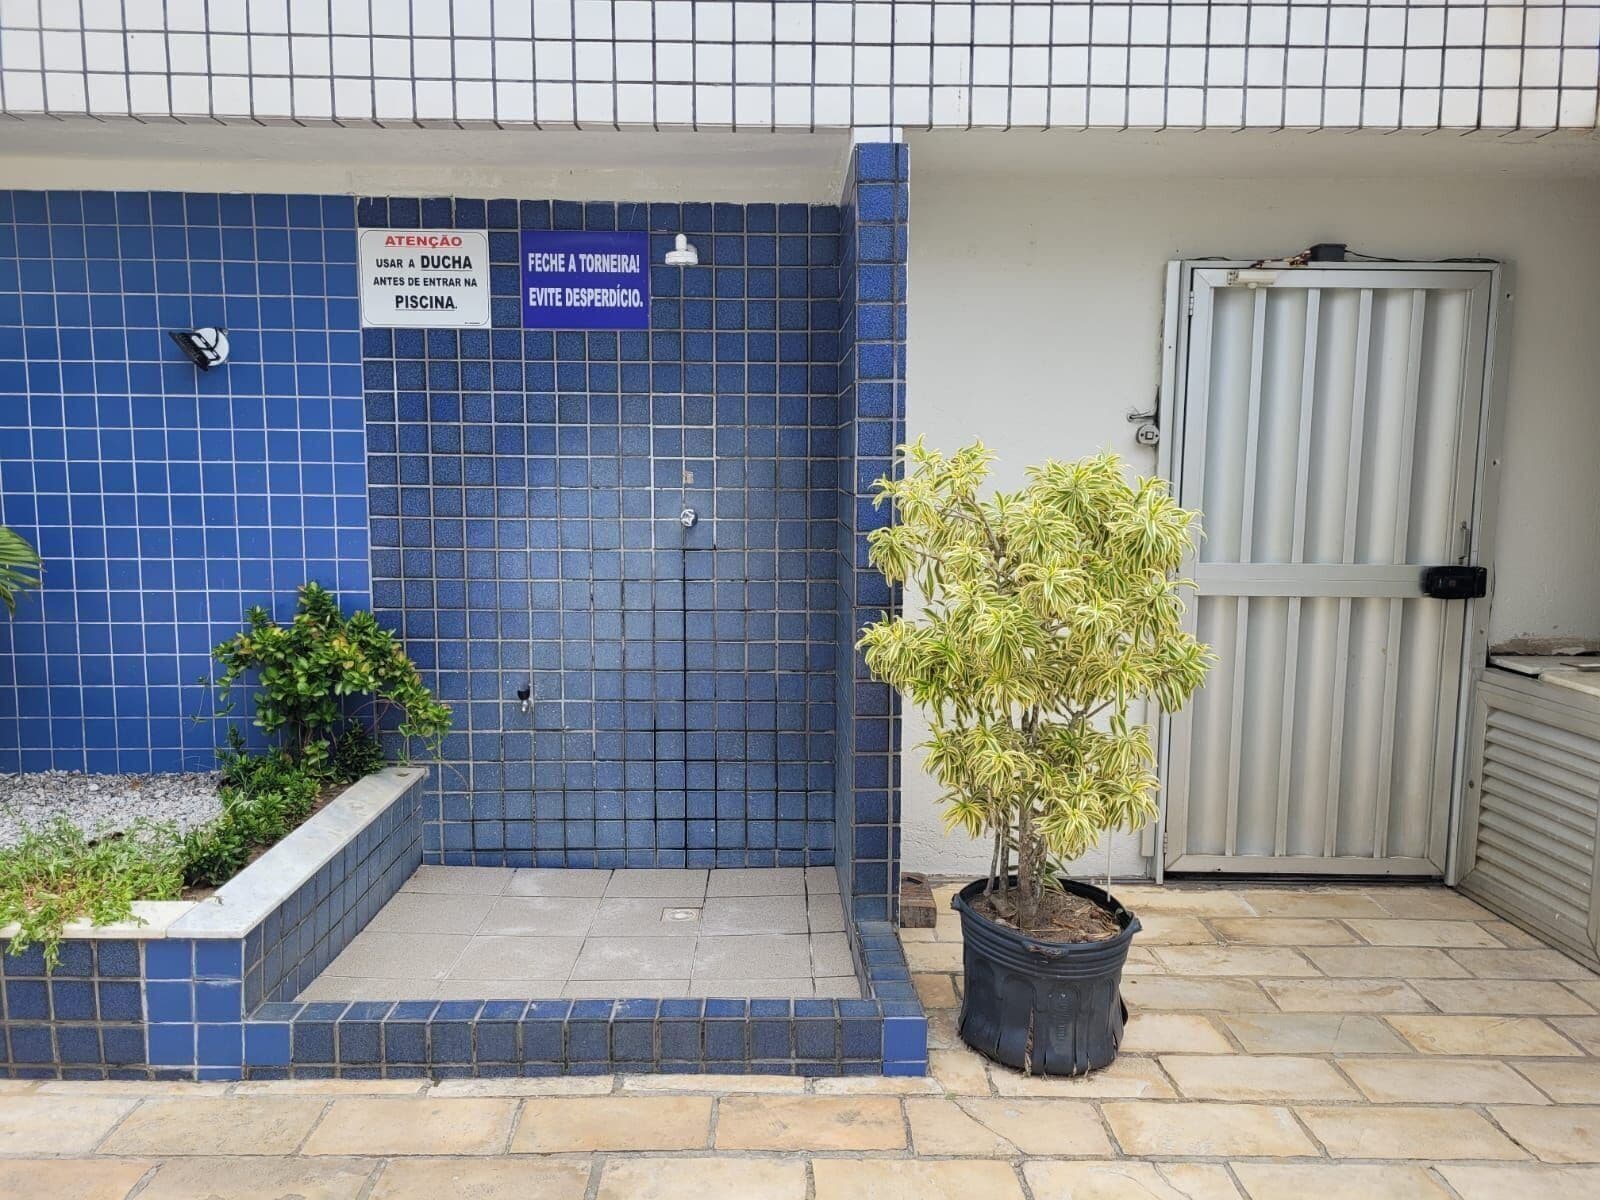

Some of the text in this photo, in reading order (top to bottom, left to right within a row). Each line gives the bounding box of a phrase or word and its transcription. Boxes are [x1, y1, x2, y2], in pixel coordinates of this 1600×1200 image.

[385, 235, 462, 248] ATENÇÃO
[376, 255, 472, 269] USAR A DUCHA
[528, 253, 640, 273] FECHE A TORNEIRA!
[373, 277, 478, 287] ANTES DE ENTRAR NA
[395, 295, 458, 309] PISCINA.
[529, 284, 644, 308] EVITE DESPERDÍCIO.
